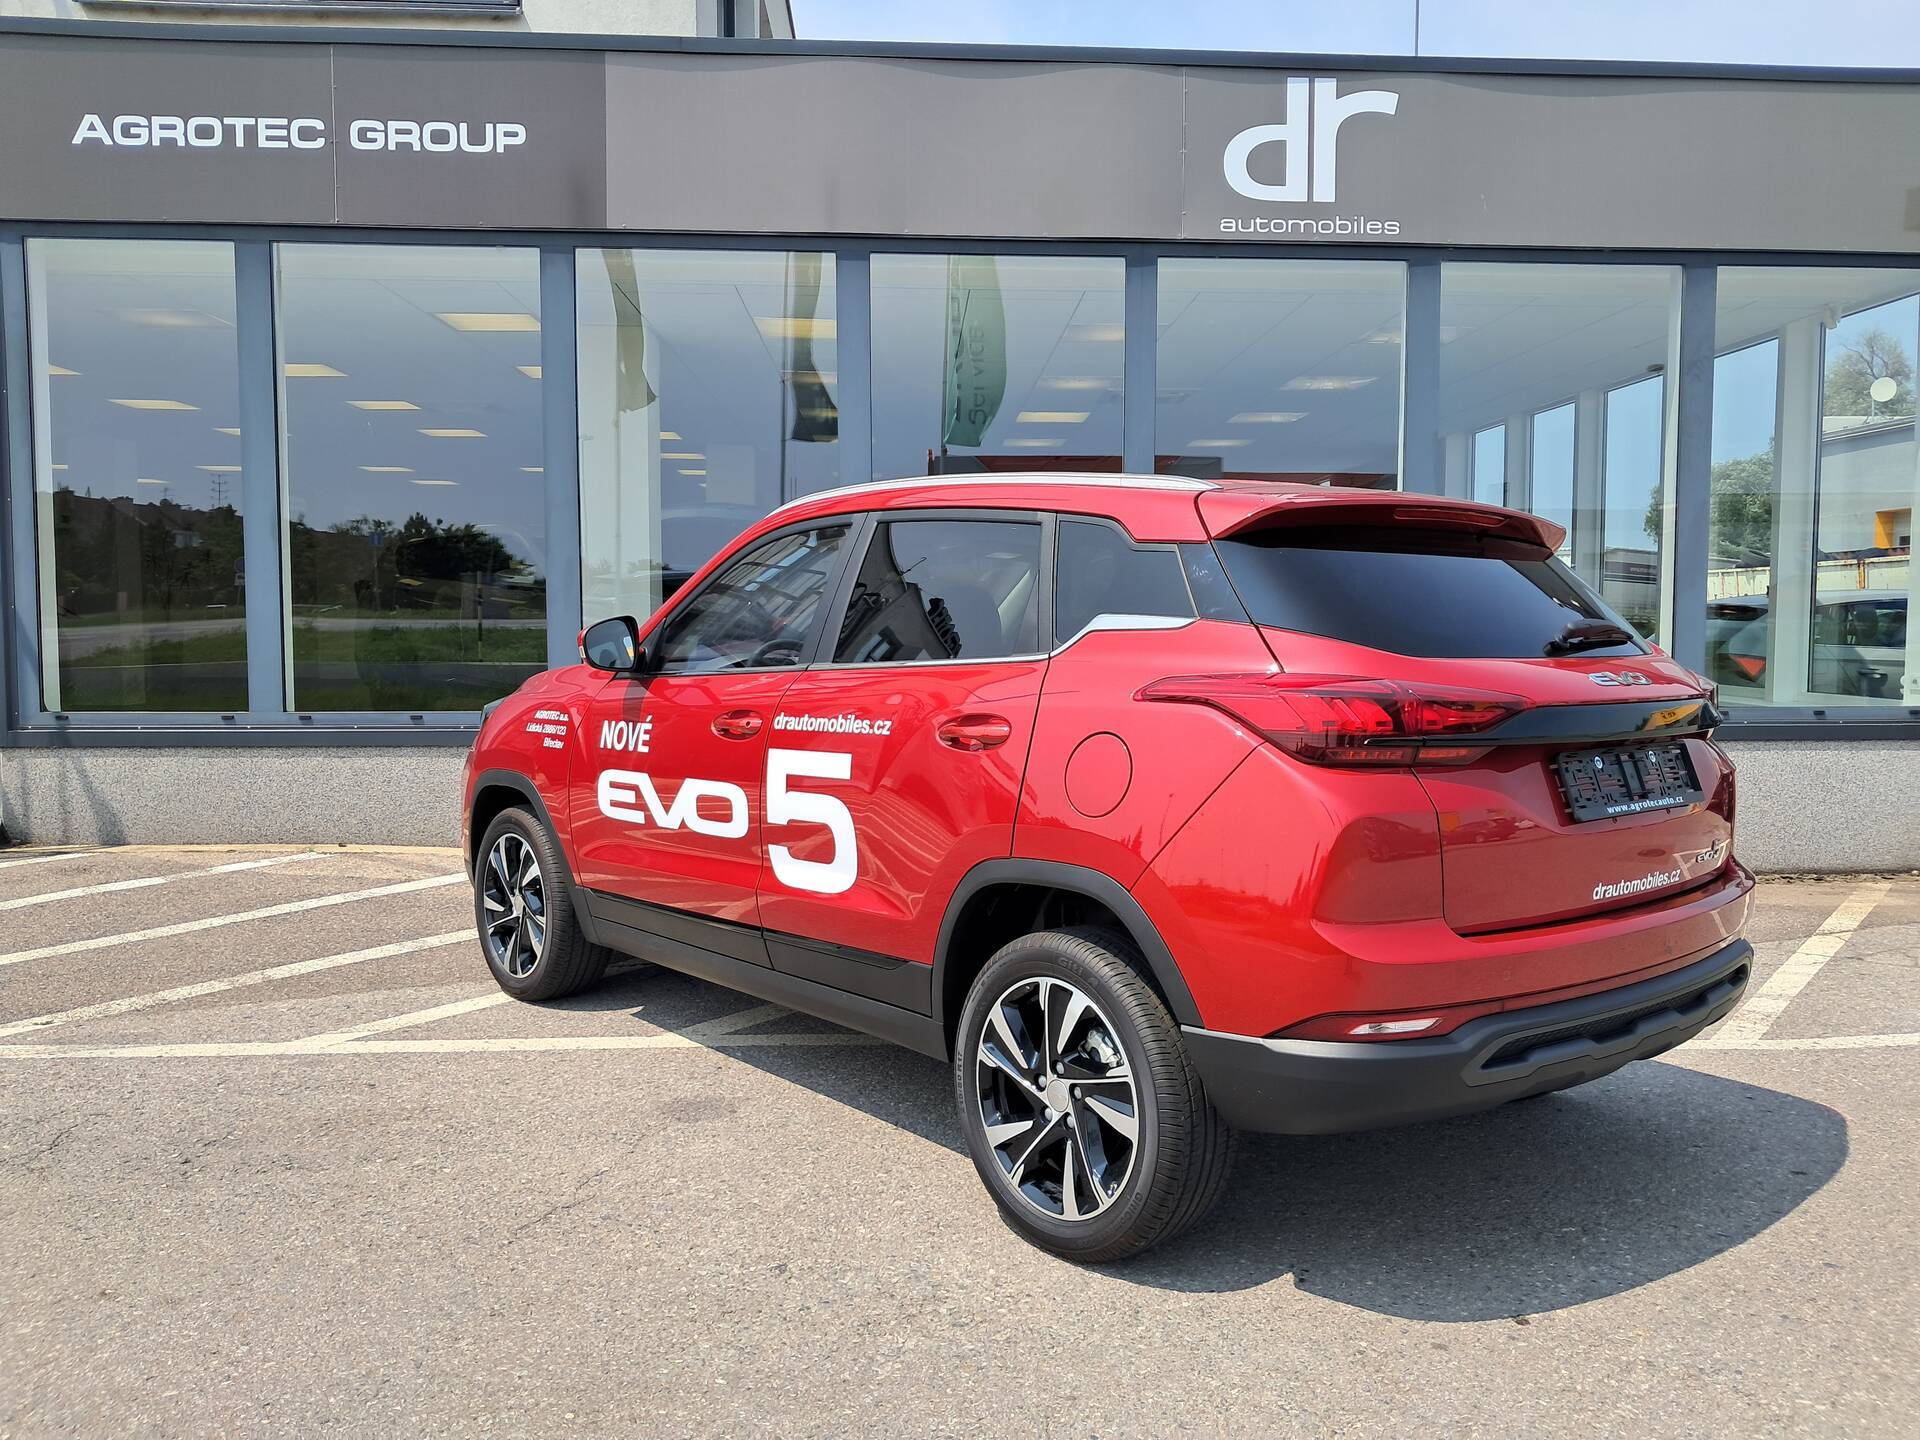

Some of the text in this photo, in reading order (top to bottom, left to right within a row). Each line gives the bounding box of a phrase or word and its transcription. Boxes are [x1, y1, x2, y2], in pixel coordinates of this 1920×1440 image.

[72, 114, 528, 153] AGROTEC GROUP
[1223, 77, 1399, 203] dr
[1220, 216, 1400, 235] automobiles
[1587, 671, 1653, 687] EVO
[600, 715, 653, 753] NOVÉ
[773, 711, 893, 736] drautomobiles.cz
[597, 748, 858, 894] EVO 5
[1606, 796, 1684, 815] www.agrotecauto.cz
[1592, 868, 1682, 901] drautomobiles.cz
